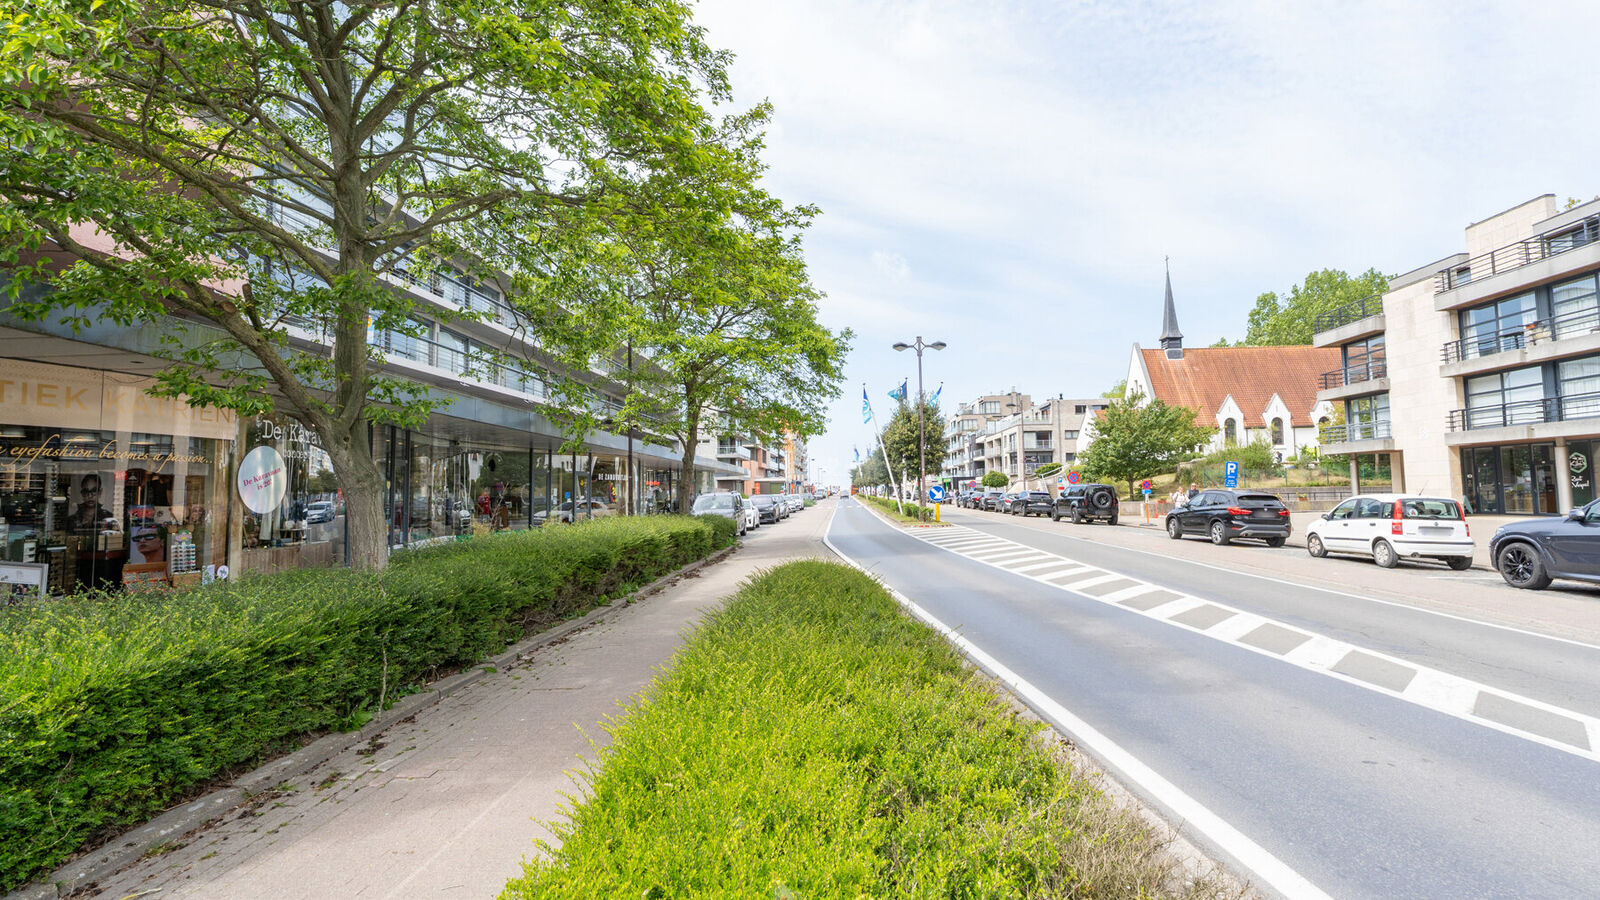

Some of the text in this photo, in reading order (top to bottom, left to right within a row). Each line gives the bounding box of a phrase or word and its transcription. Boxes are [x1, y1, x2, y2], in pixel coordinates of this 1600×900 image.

[262, 419, 281, 440] De
[99, 440, 149, 460] becomes
[152, 452, 164, 461] a
[1228, 463, 1236, 475] P
